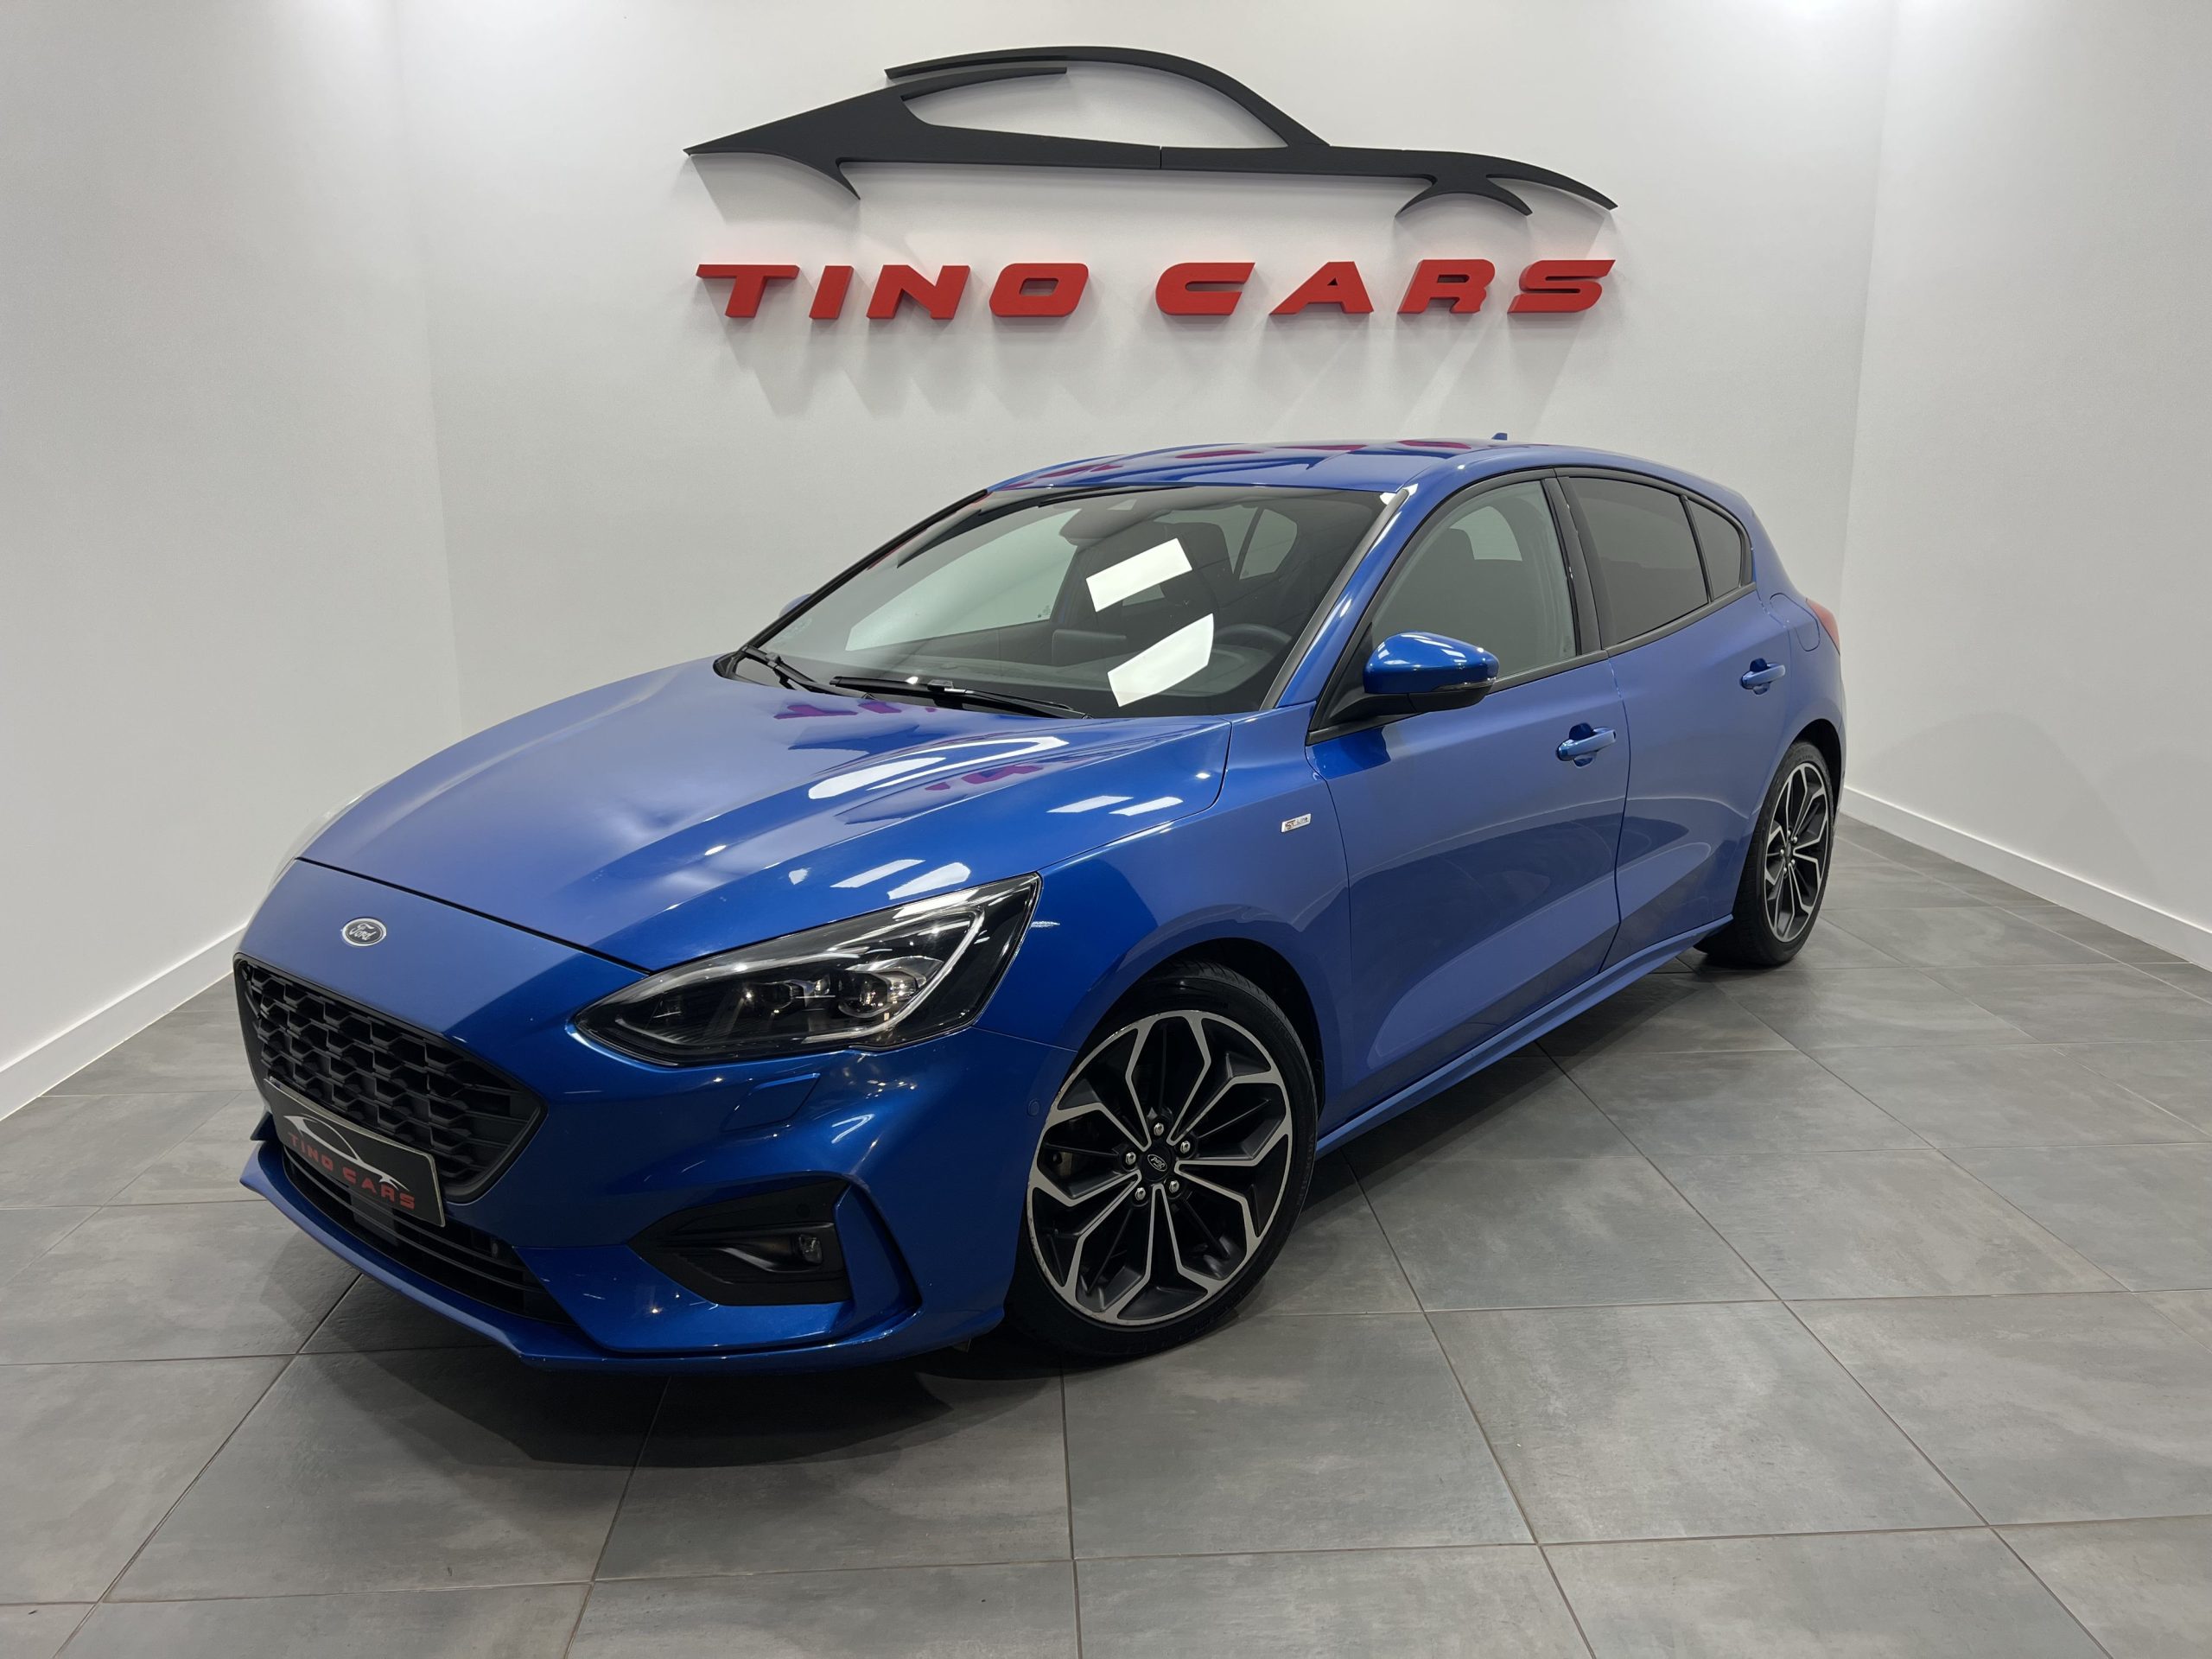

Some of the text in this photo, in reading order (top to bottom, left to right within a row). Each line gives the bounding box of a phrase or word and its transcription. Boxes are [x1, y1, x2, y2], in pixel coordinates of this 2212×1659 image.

[696, 259, 1616, 319] TINO CARS
[349, 923, 377, 941] Ford
[289, 1132, 415, 1210] TINO CARS
